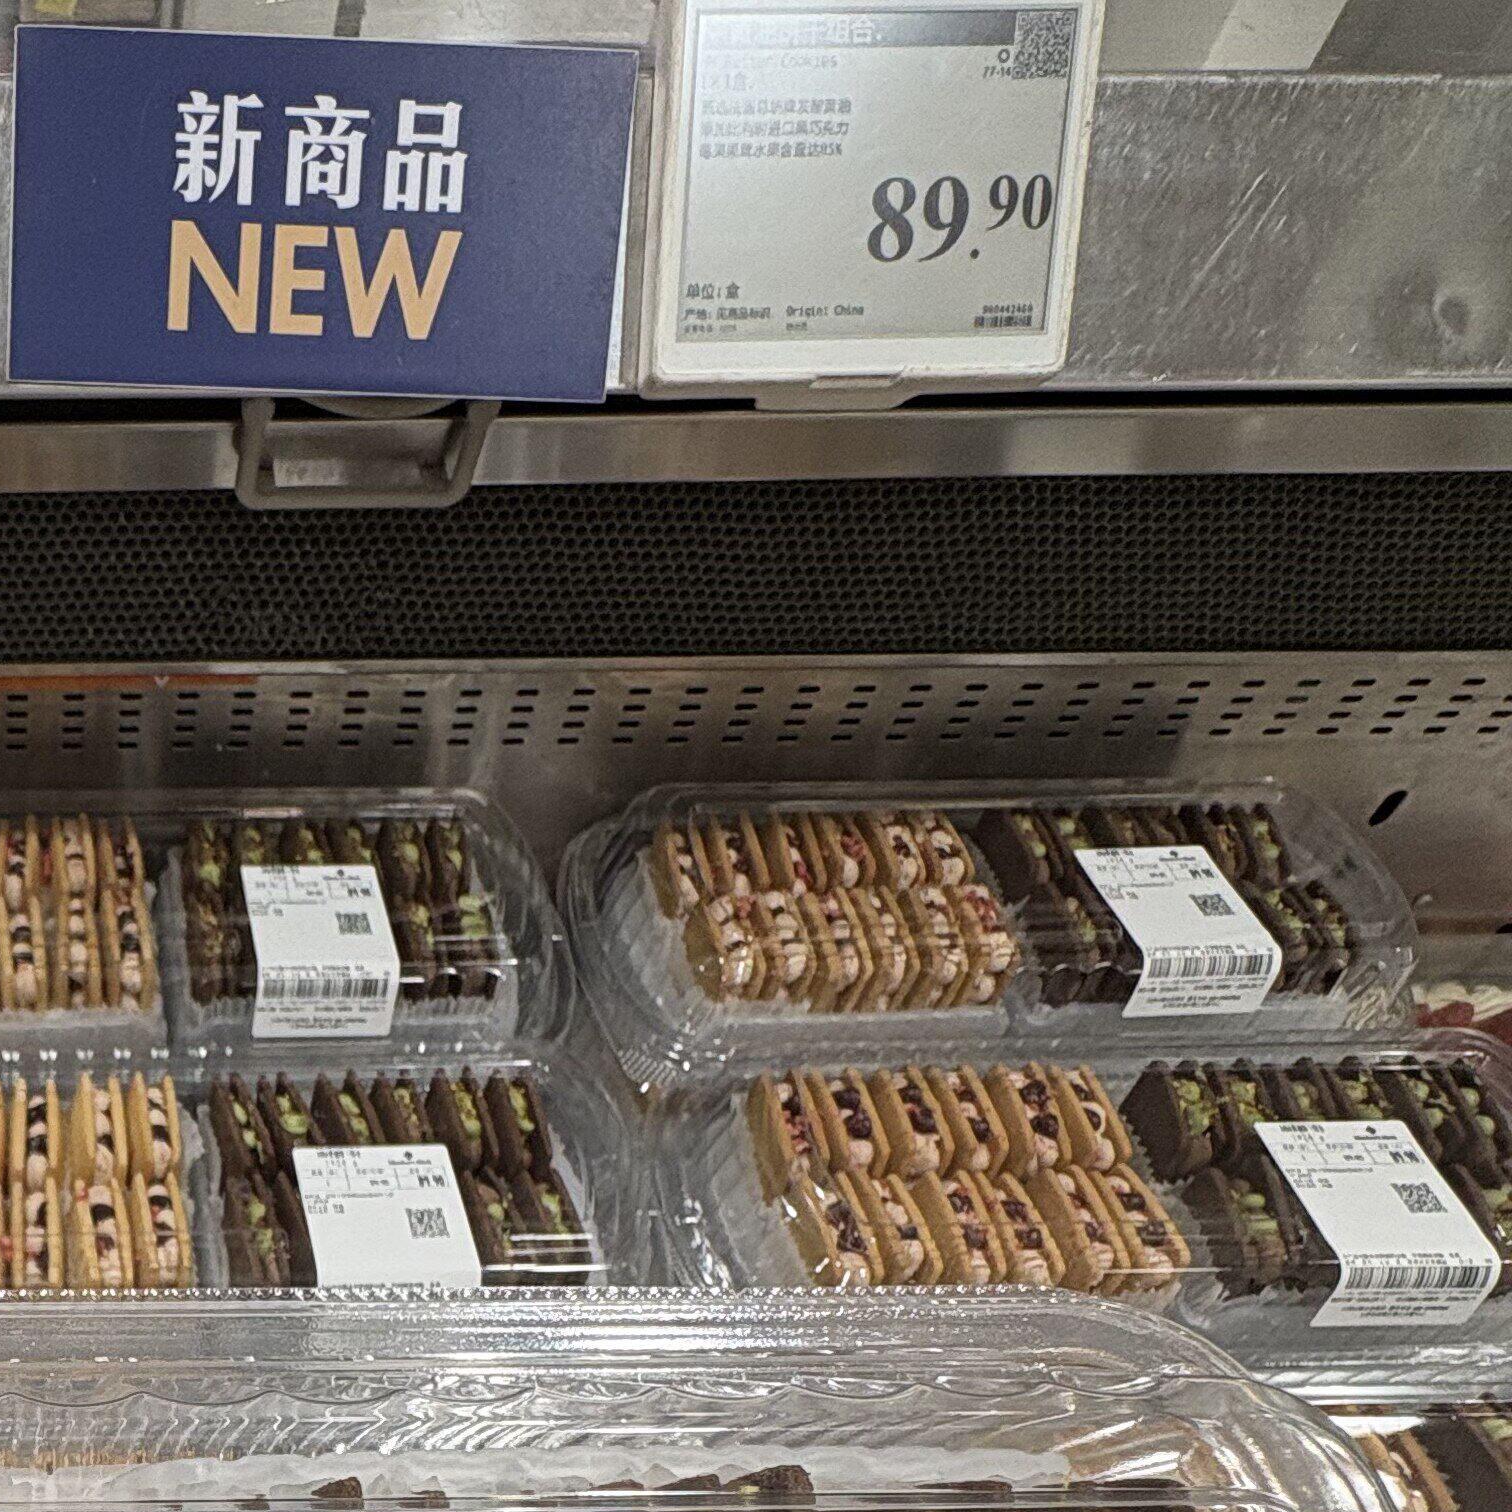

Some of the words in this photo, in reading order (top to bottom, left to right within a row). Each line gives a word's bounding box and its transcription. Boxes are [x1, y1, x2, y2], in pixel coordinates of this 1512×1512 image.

[172, 90, 467, 213] 新商品
[867, 173, 1053, 263] 89.90
[167, 219, 463, 340] NEW
[834, 304, 864, 316] China
